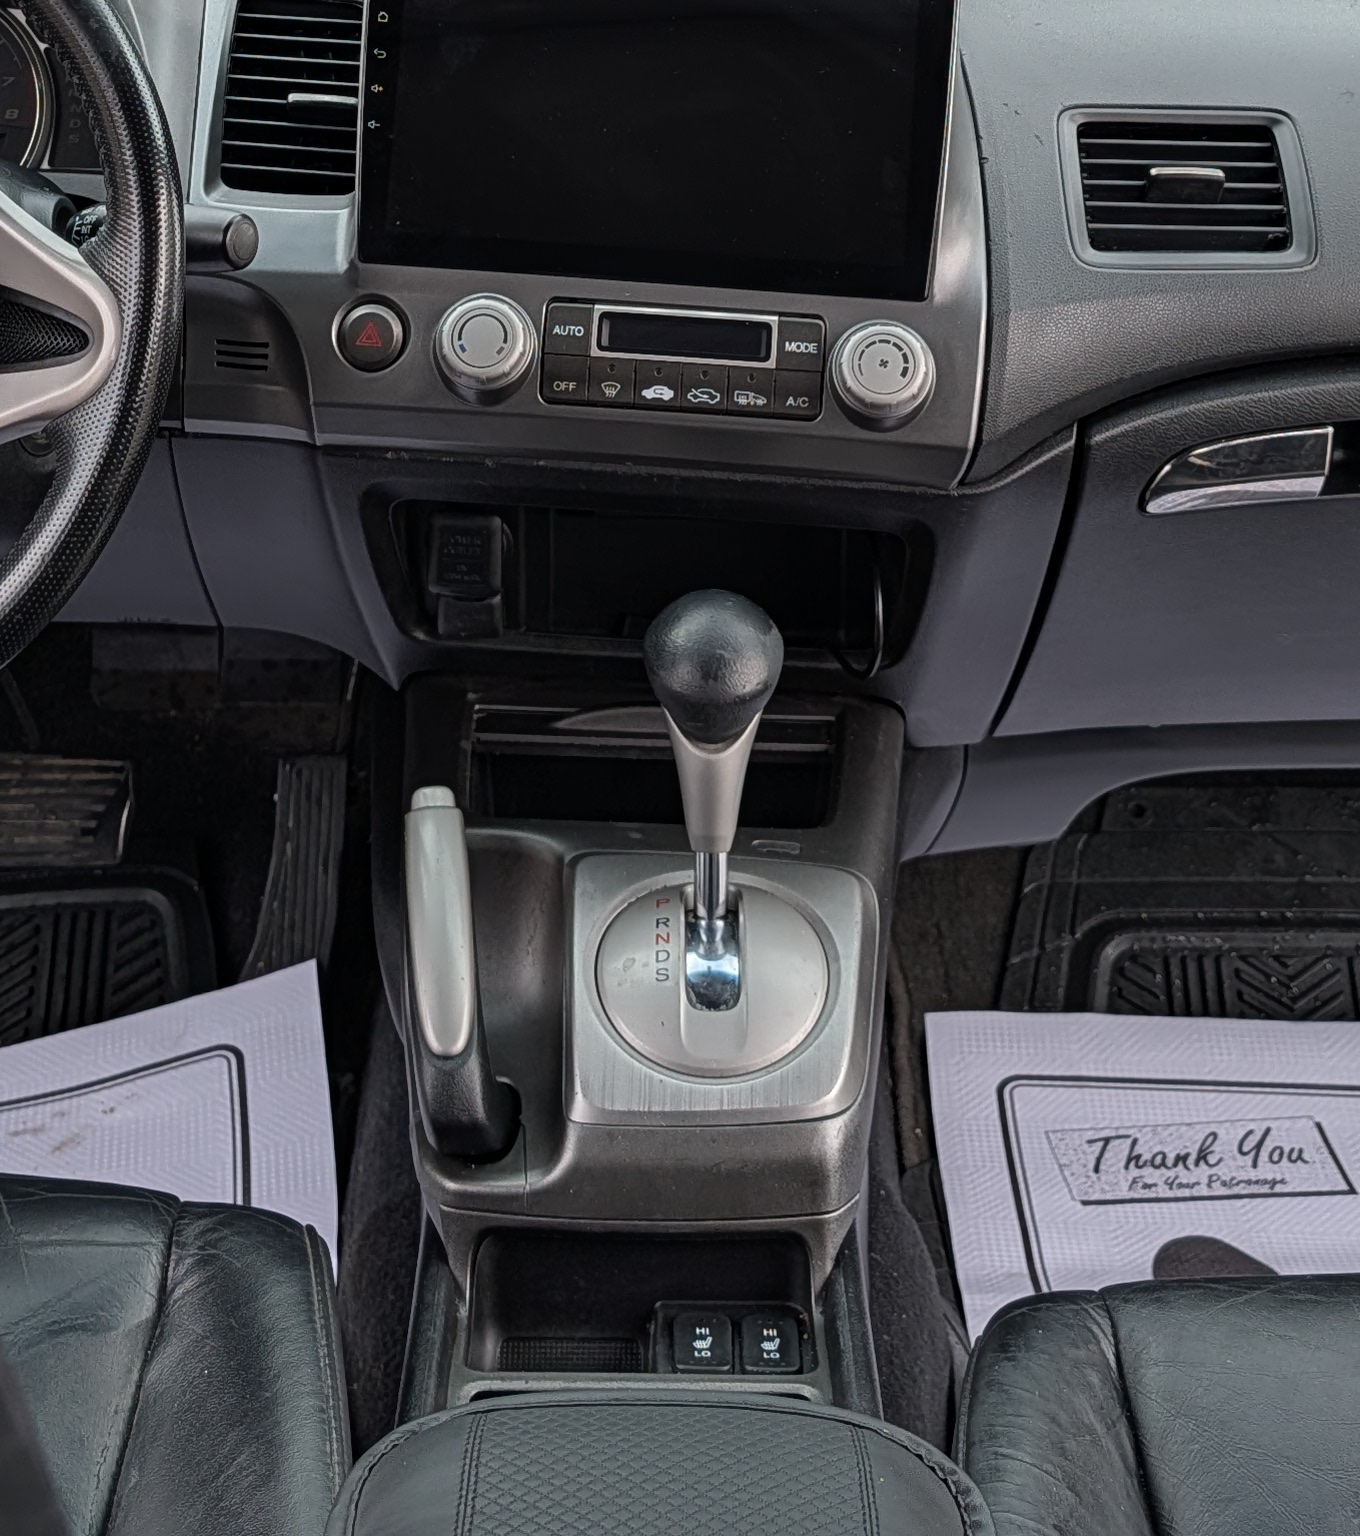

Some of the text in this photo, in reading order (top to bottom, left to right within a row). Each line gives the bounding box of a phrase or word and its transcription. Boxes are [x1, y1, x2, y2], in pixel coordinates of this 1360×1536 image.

[1, 76, 16, 87] 7
[4, 109, 19, 120] 8
[83, 215, 99, 224] OFF
[552, 325, 585, 337] AUTO
[785, 341, 819, 353] MODE
[552, 380, 577, 392] OFF
[785, 396, 809, 408] A/C
[655, 897, 671, 909] P
[655, 916, 671, 929] R
[655, 931, 671, 945] N
[655, 949, 671, 963] D
[655, 967, 670, 982] S
[1086, 1126, 1311, 1174] Thank You
[1128, 1175, 1159, 1192] For
[695, 1327, 710, 1335] HI
[763, 1328, 778, 1337] HI
